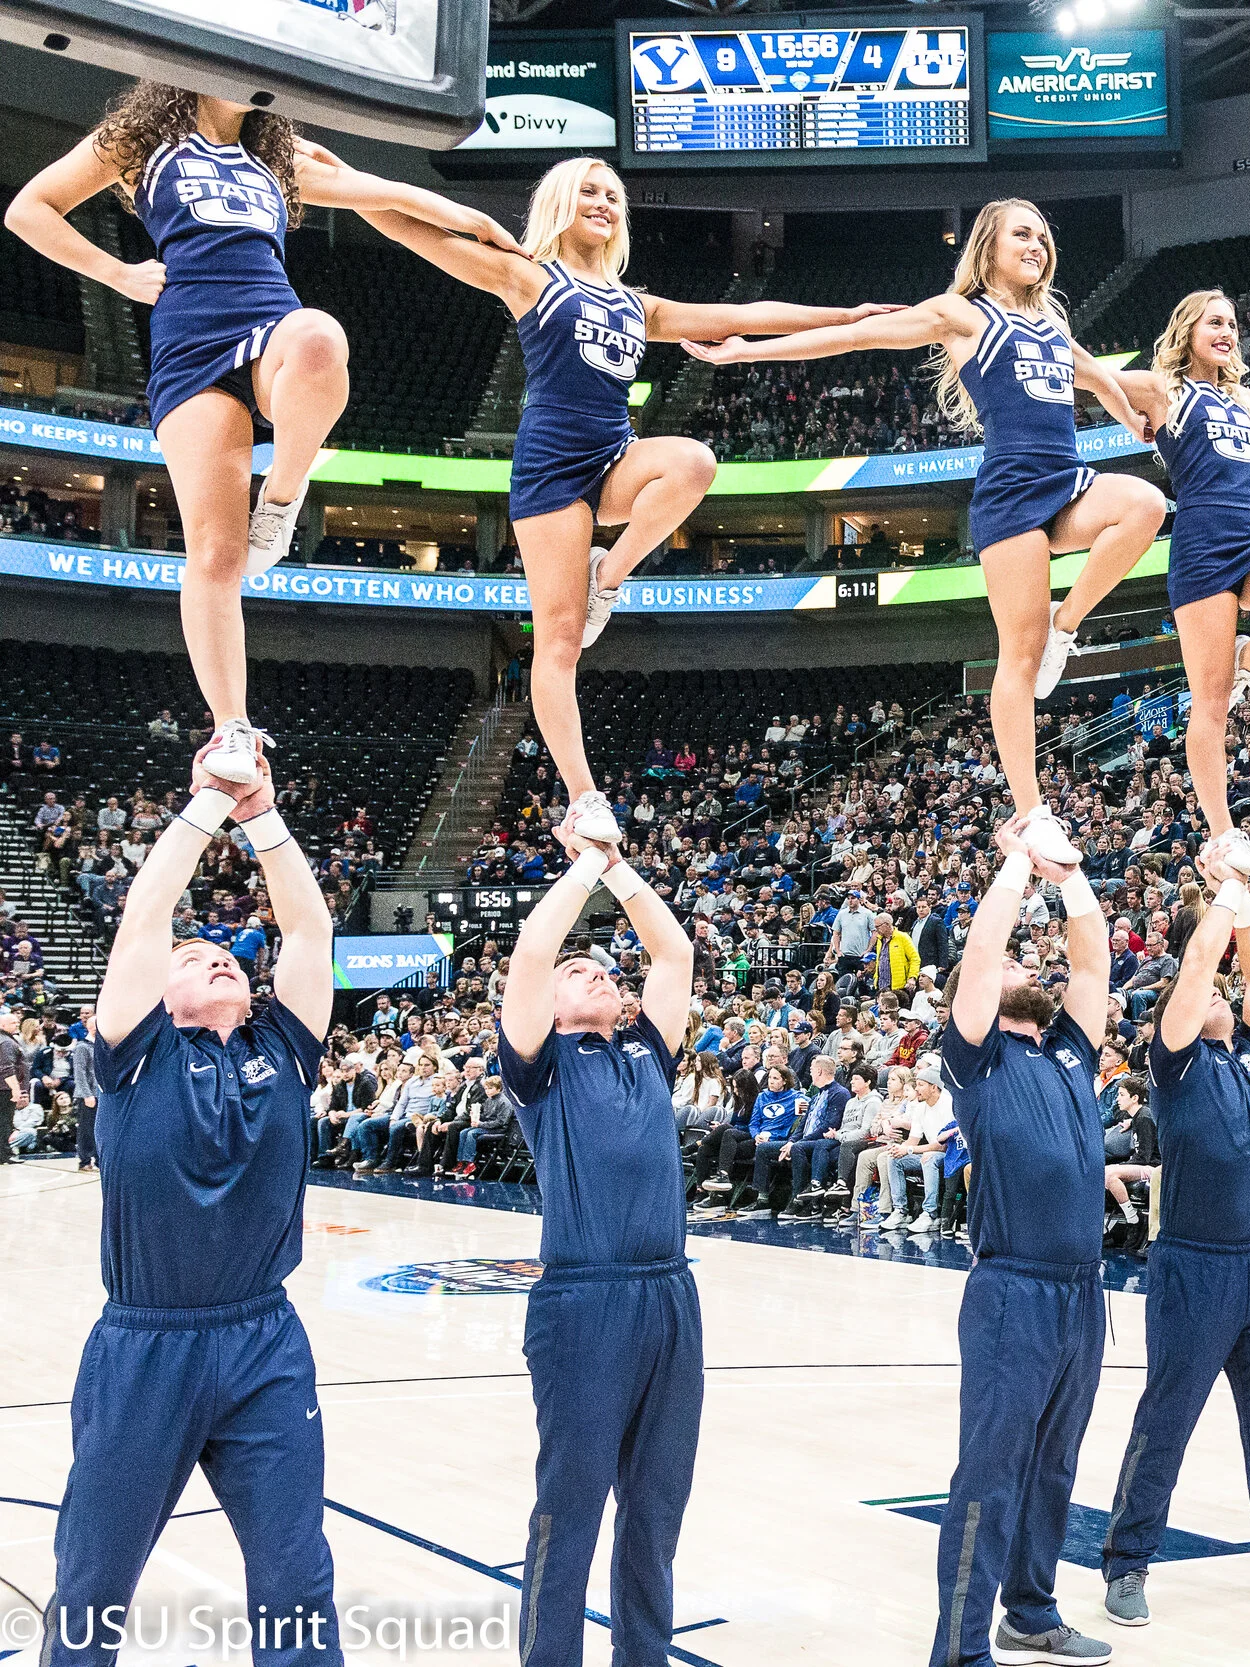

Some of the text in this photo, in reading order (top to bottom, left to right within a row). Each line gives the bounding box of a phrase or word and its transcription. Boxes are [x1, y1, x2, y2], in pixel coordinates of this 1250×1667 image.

[716, 47, 736, 72] 9
[862, 45, 883, 69] 4
[486, 61, 515, 78] end
[998, 72, 1157, 94] AMERICA FIRST
[1034, 93, 1121, 103] CREDIT UNION
[513, 114, 568, 134] Divvy
[175, 178, 280, 219] STATE
[574, 318, 646, 366] STATE
[1013, 360, 1075, 384] STATE
[0, 417, 25, 435] HO
[32, 423, 88, 444] KEEPS
[93, 433, 118, 449] US
[123, 437, 144, 452] IN
[893, 462, 914, 477] WE
[918, 455, 978, 475] HAVEN'T
[1108, 432, 1137, 449] KEE
[49, 552, 92, 576] WE
[103, 558, 184, 583] HAVE
[249, 574, 400, 600] ORGOTTEN
[411, 582, 475, 603] WHO
[484, 585, 531, 604] KEE
[475, 891, 512, 908] 15:56
[459, 920, 469, 933] 2
[346, 953, 438, 969] ZIONS BANK
